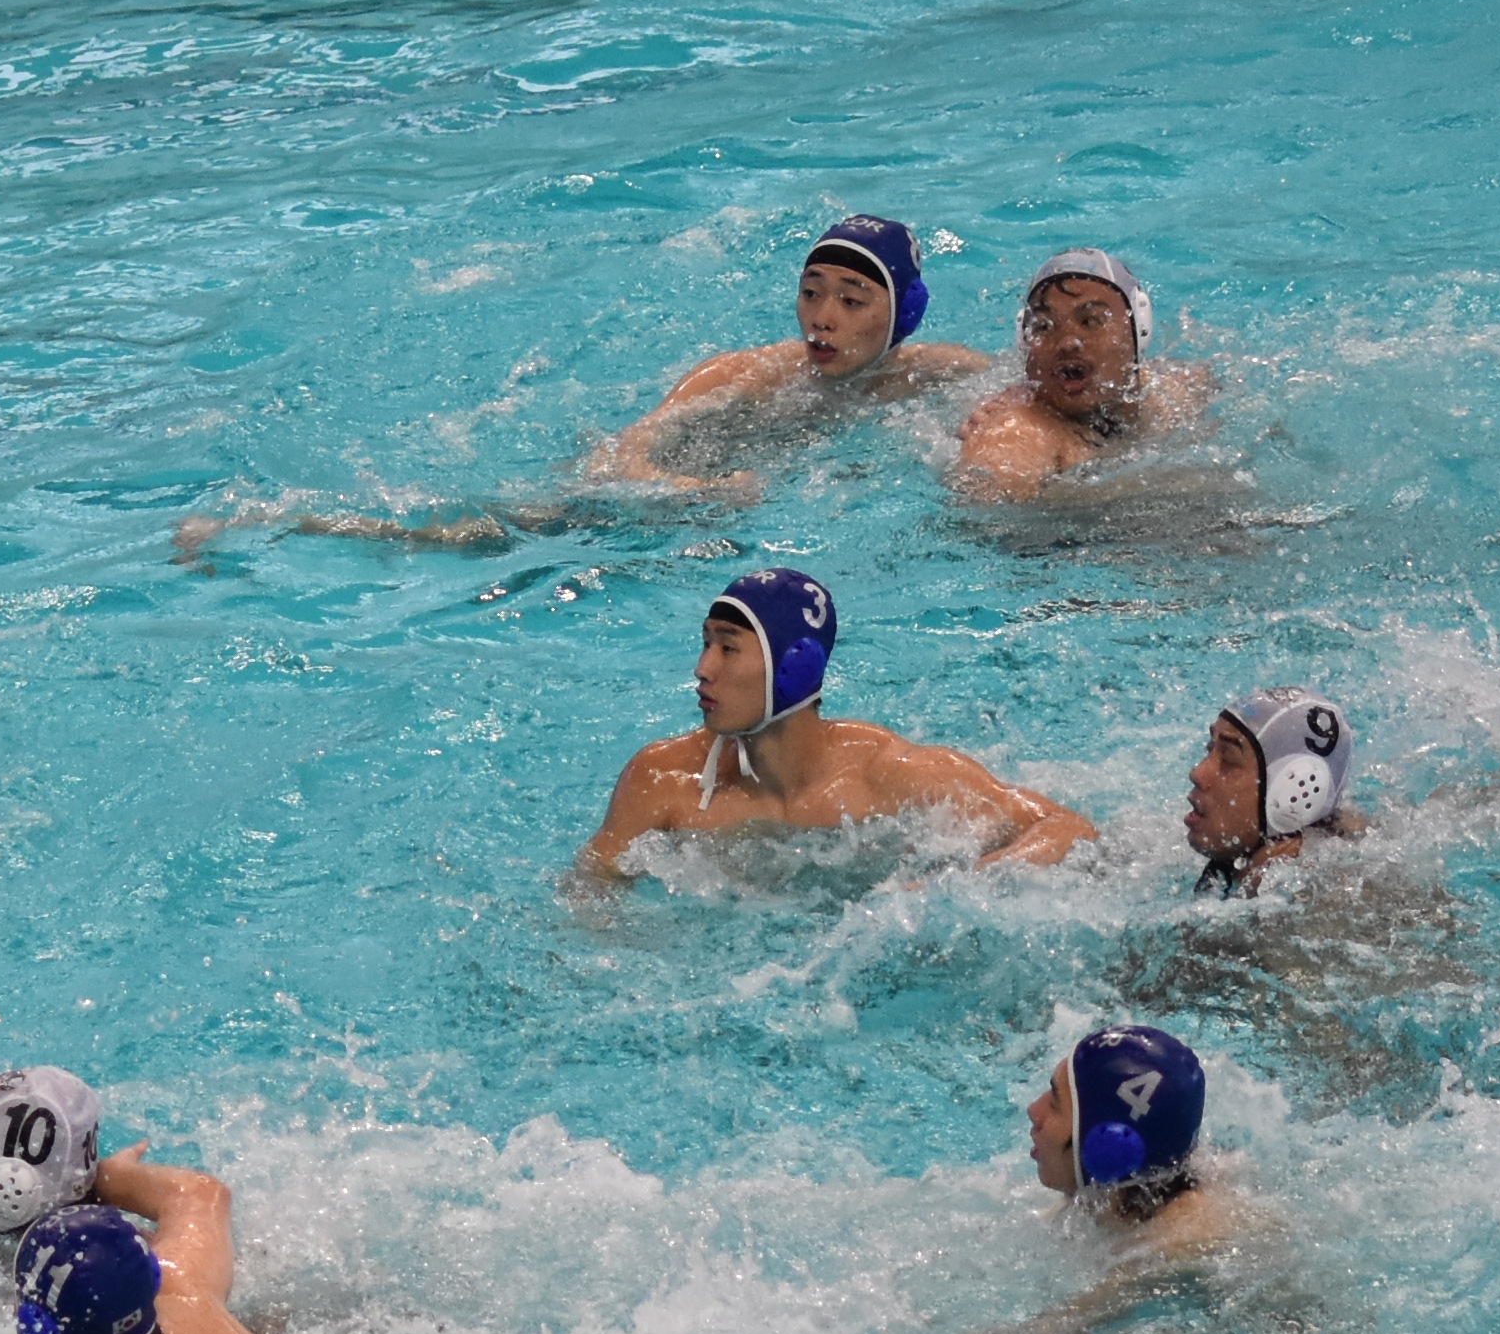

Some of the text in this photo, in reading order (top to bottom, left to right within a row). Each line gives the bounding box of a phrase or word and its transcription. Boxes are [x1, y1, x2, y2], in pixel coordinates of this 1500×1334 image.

[802, 583, 827, 629] 3
[1304, 706, 1340, 758] 9
[1116, 1070, 1164, 1122] 4
[2, 1102, 57, 1166] 10
